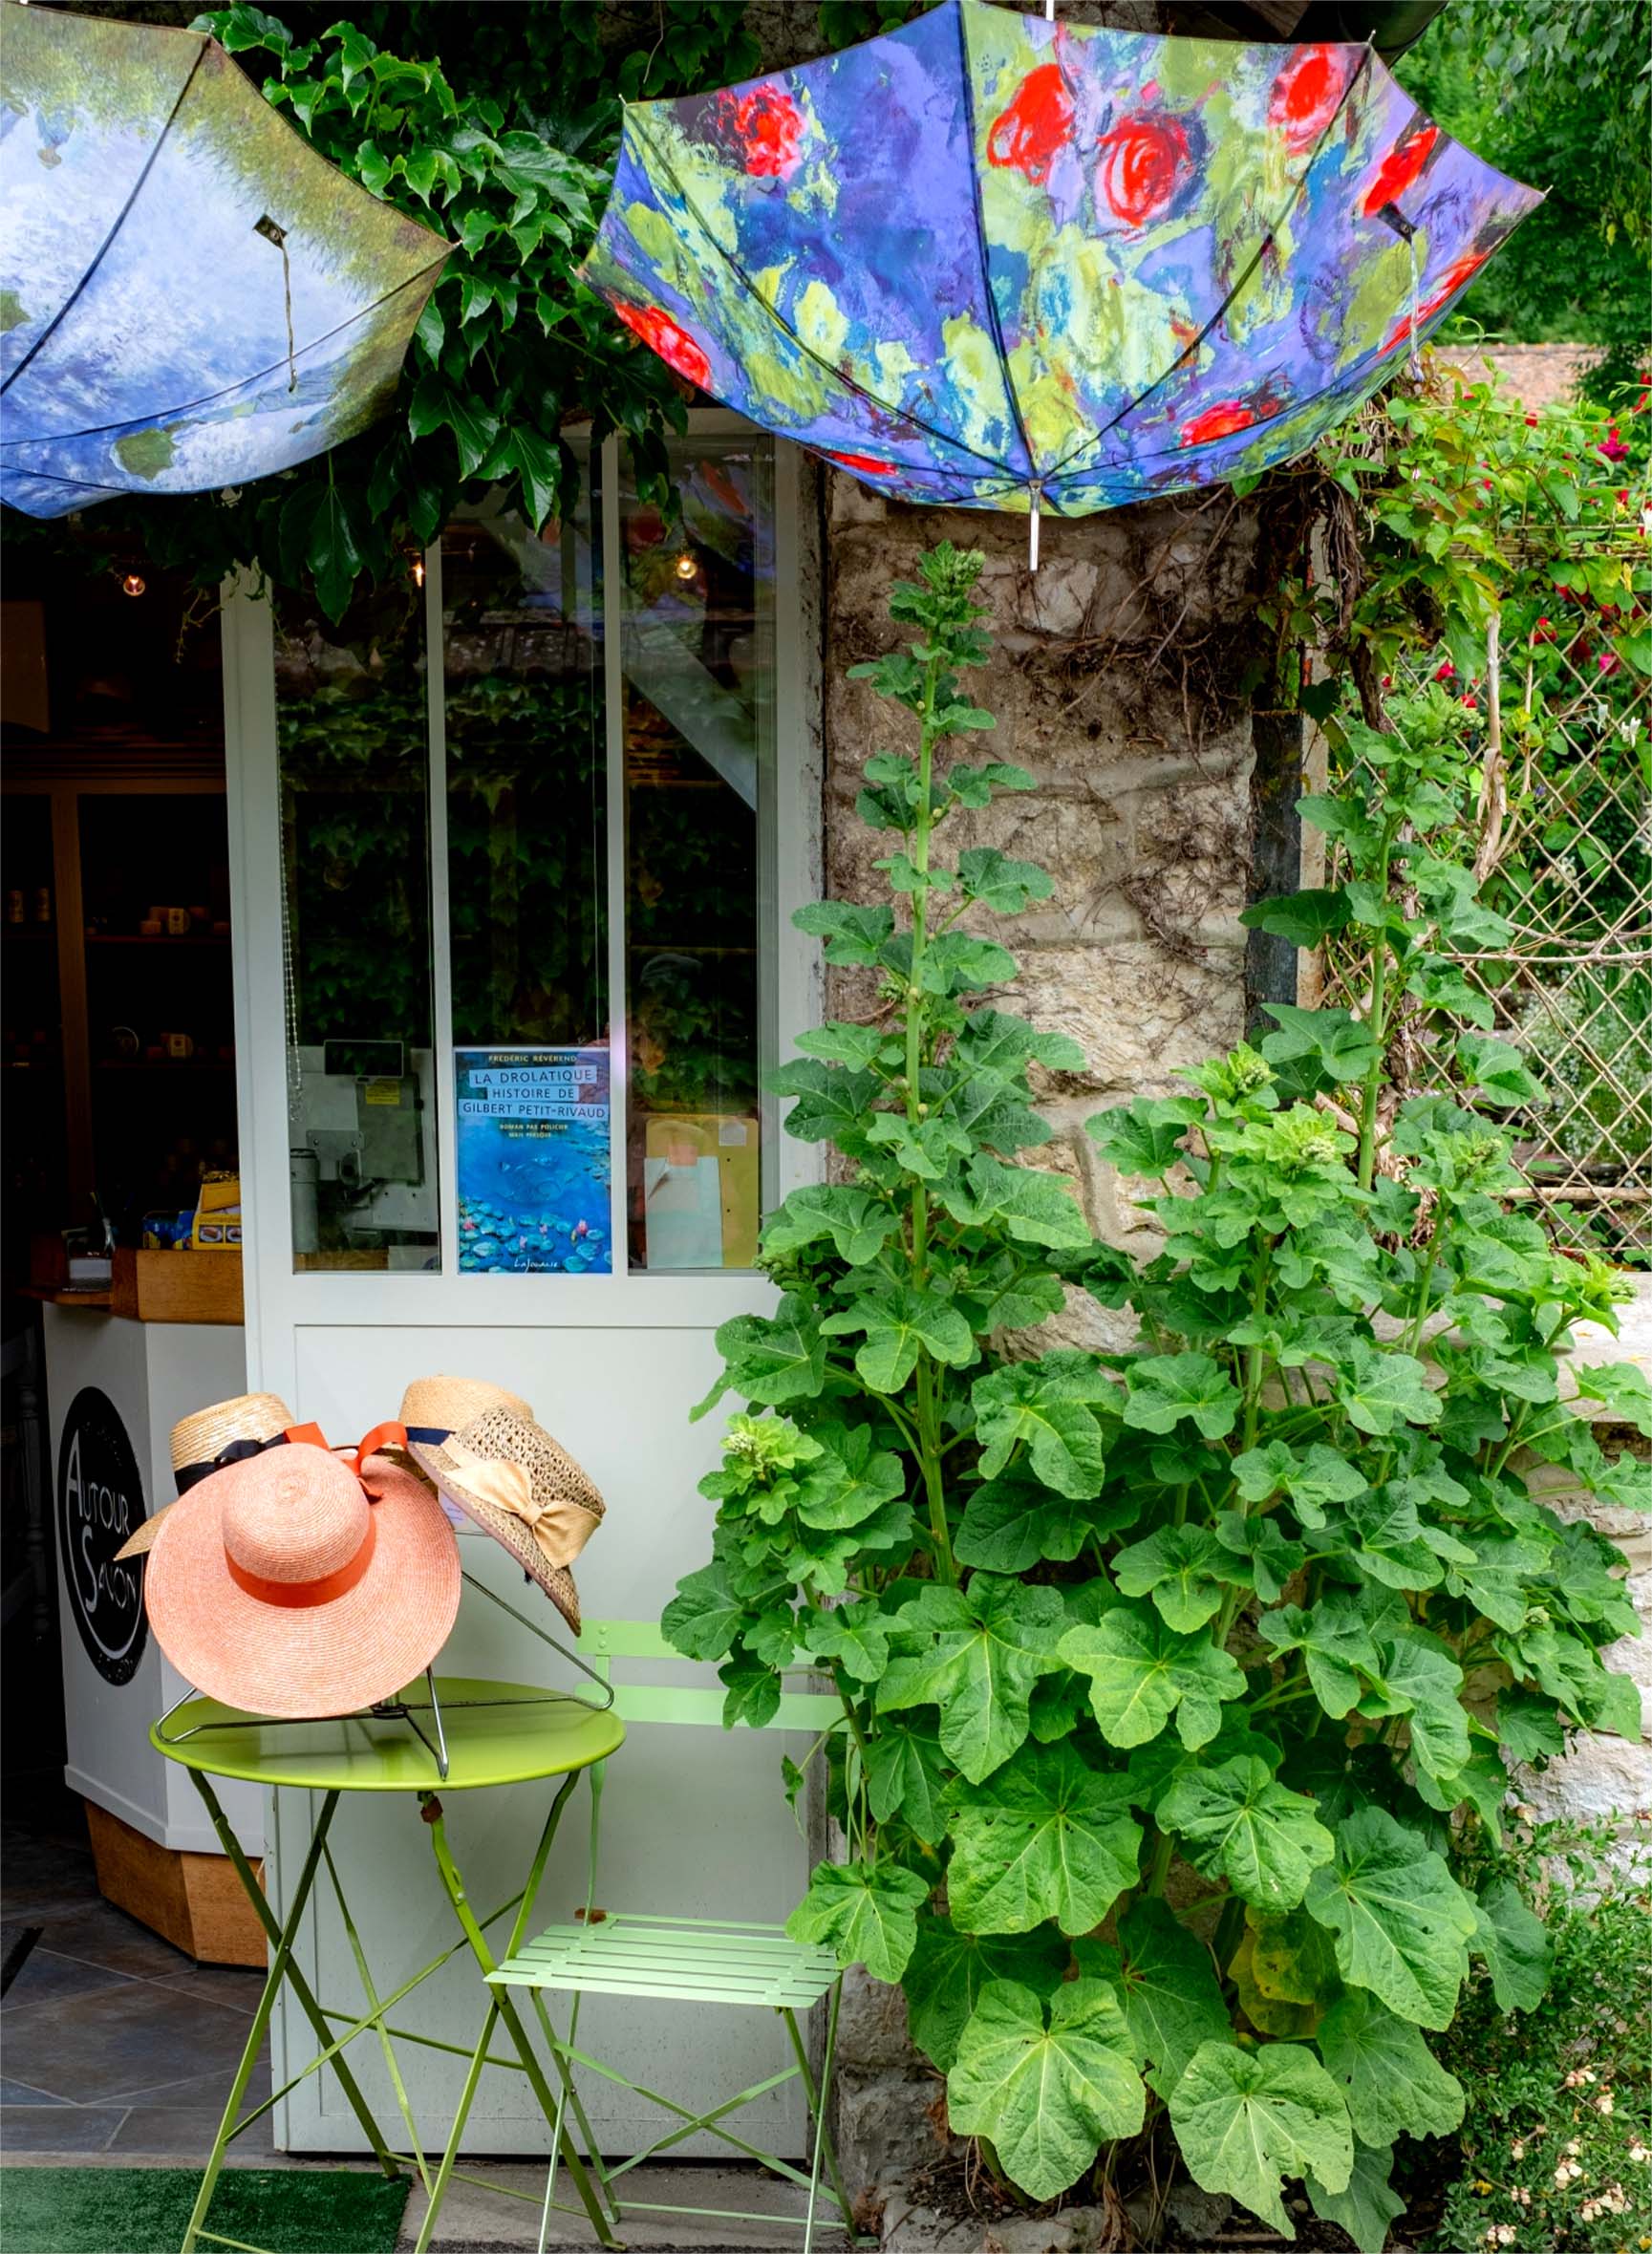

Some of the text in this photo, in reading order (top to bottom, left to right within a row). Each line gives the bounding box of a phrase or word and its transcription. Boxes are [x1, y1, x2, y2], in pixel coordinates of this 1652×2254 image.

[475, 1068, 592, 1084] LA DROLATIQUE
[492, 1087, 574, 1099] HISTOIRE DE
[462, 1102, 606, 1118] GILBERT PETIT-RIVAUD
